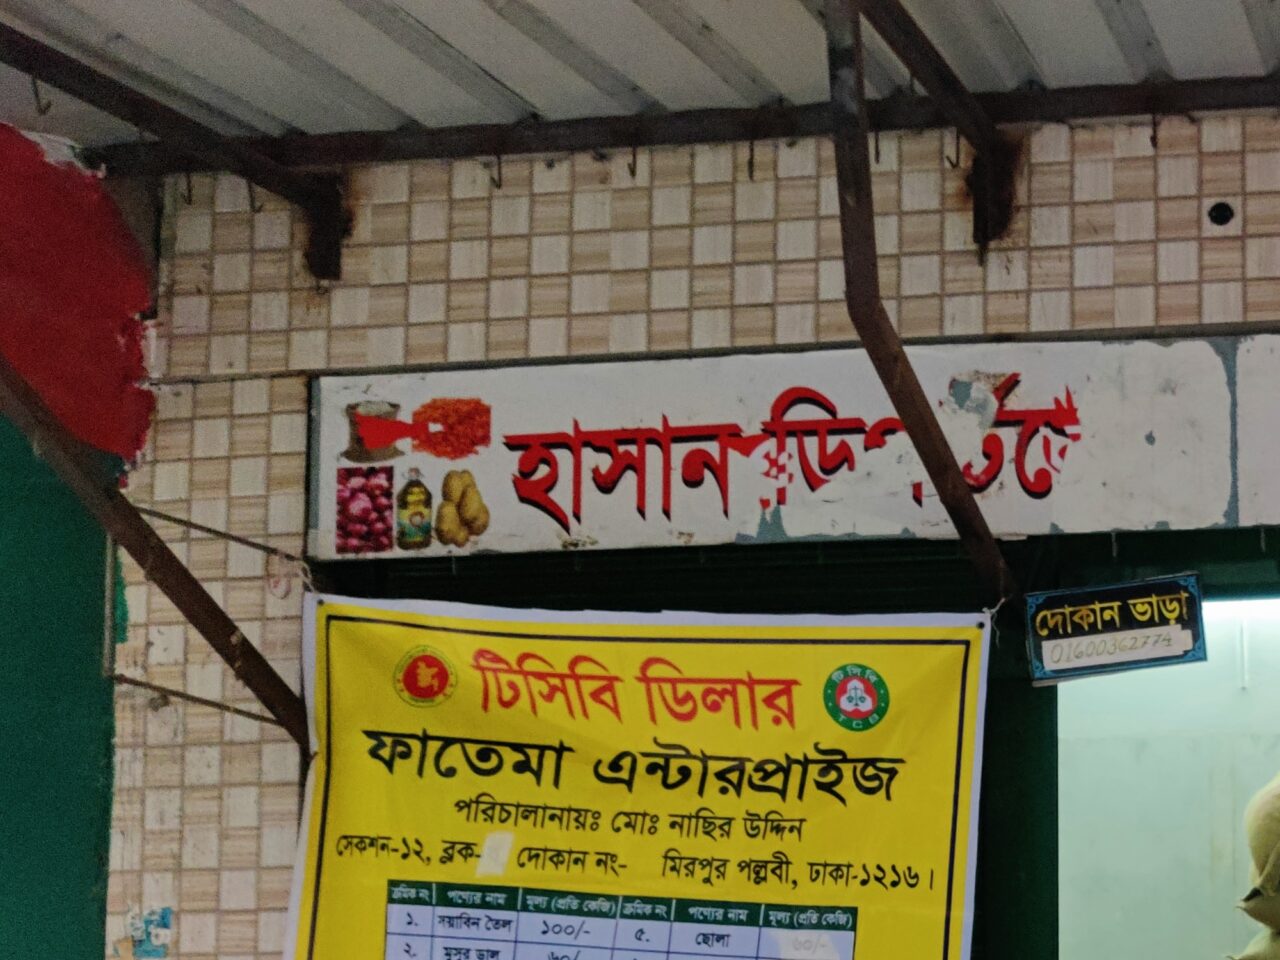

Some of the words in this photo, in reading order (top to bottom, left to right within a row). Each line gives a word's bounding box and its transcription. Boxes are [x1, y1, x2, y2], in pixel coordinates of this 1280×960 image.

[503, 413, 744, 536] হাসান
[1035, 601, 1122, 637] দোকান
[1127, 590, 1189, 625] ভাড়া
[473, 648, 623, 724] টিসিবি
[636, 656, 801, 731] ডিলার
[362, 728, 575, 789] ফাতেমা
[593, 736, 905, 807] এন্টারপ্রাইজ
[611, 811, 659, 836] মোঃ
[668, 808, 735, 842] নাছির
[743, 811, 806, 843] উদ্দিন
[517, 846, 590, 872] দোকান
[596, 851, 627, 877] নং-
[662, 848, 729, 886] মিরপুর
[737, 851, 799, 891] পল্লবী,
[695, 931, 732, 948] ছোলা
